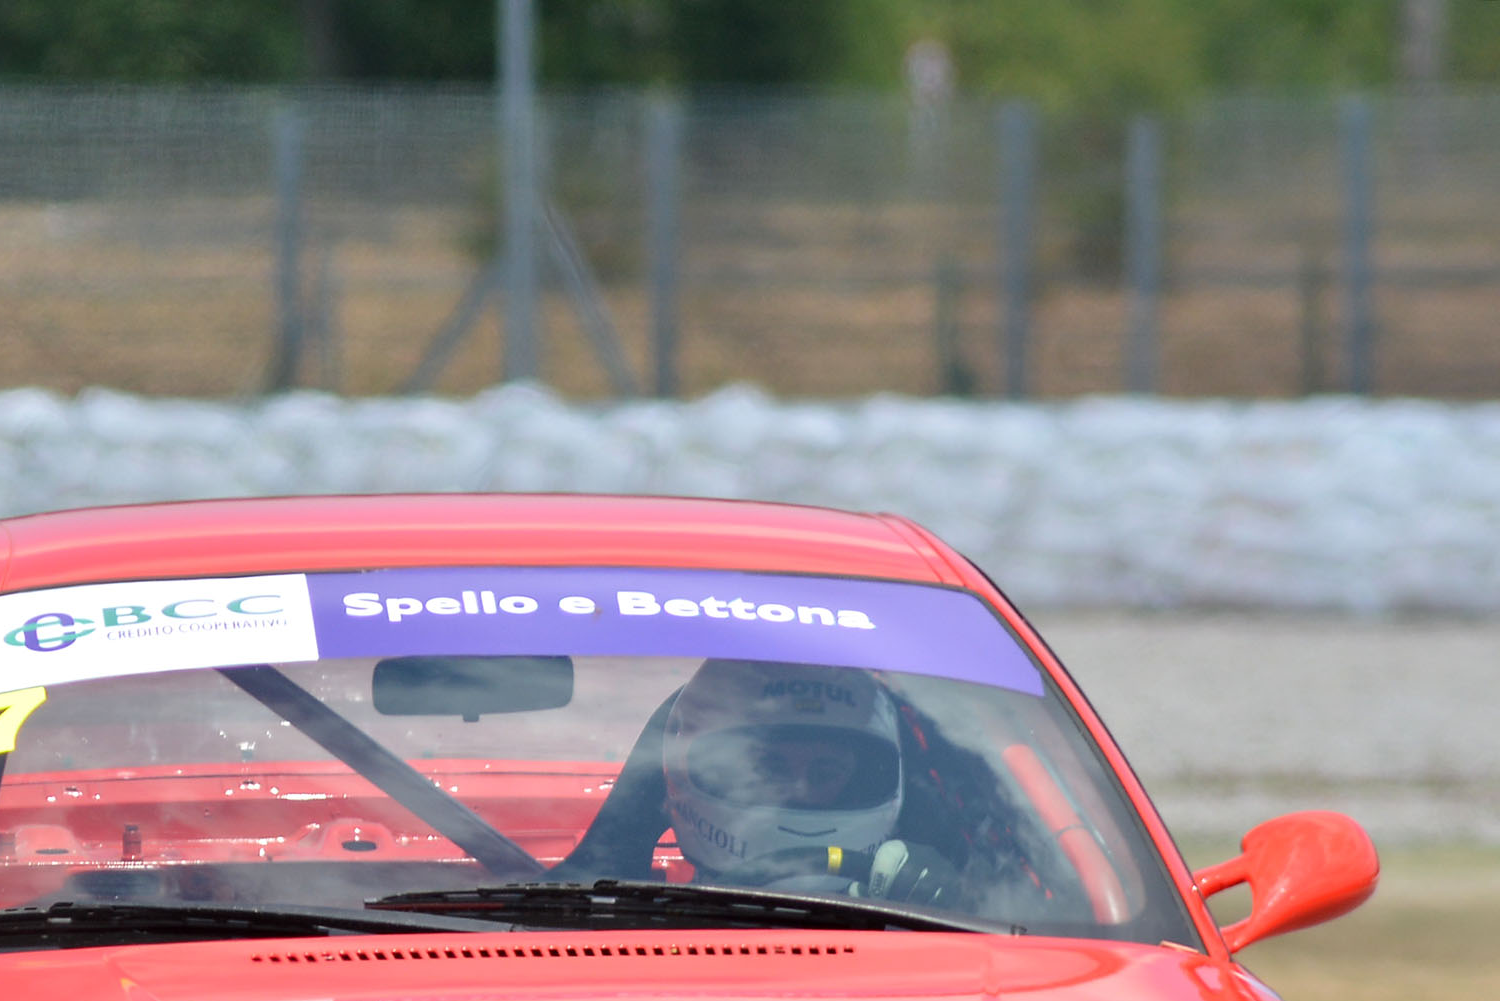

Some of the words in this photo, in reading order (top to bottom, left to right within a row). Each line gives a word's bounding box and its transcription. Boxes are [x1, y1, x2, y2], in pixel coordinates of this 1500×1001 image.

[102, 595, 284, 628] BCC
[343, 591, 539, 622] Spello
[559, 596, 597, 615] e
[617, 591, 877, 630] Bettona
[106, 625, 174, 642] CREDITO
